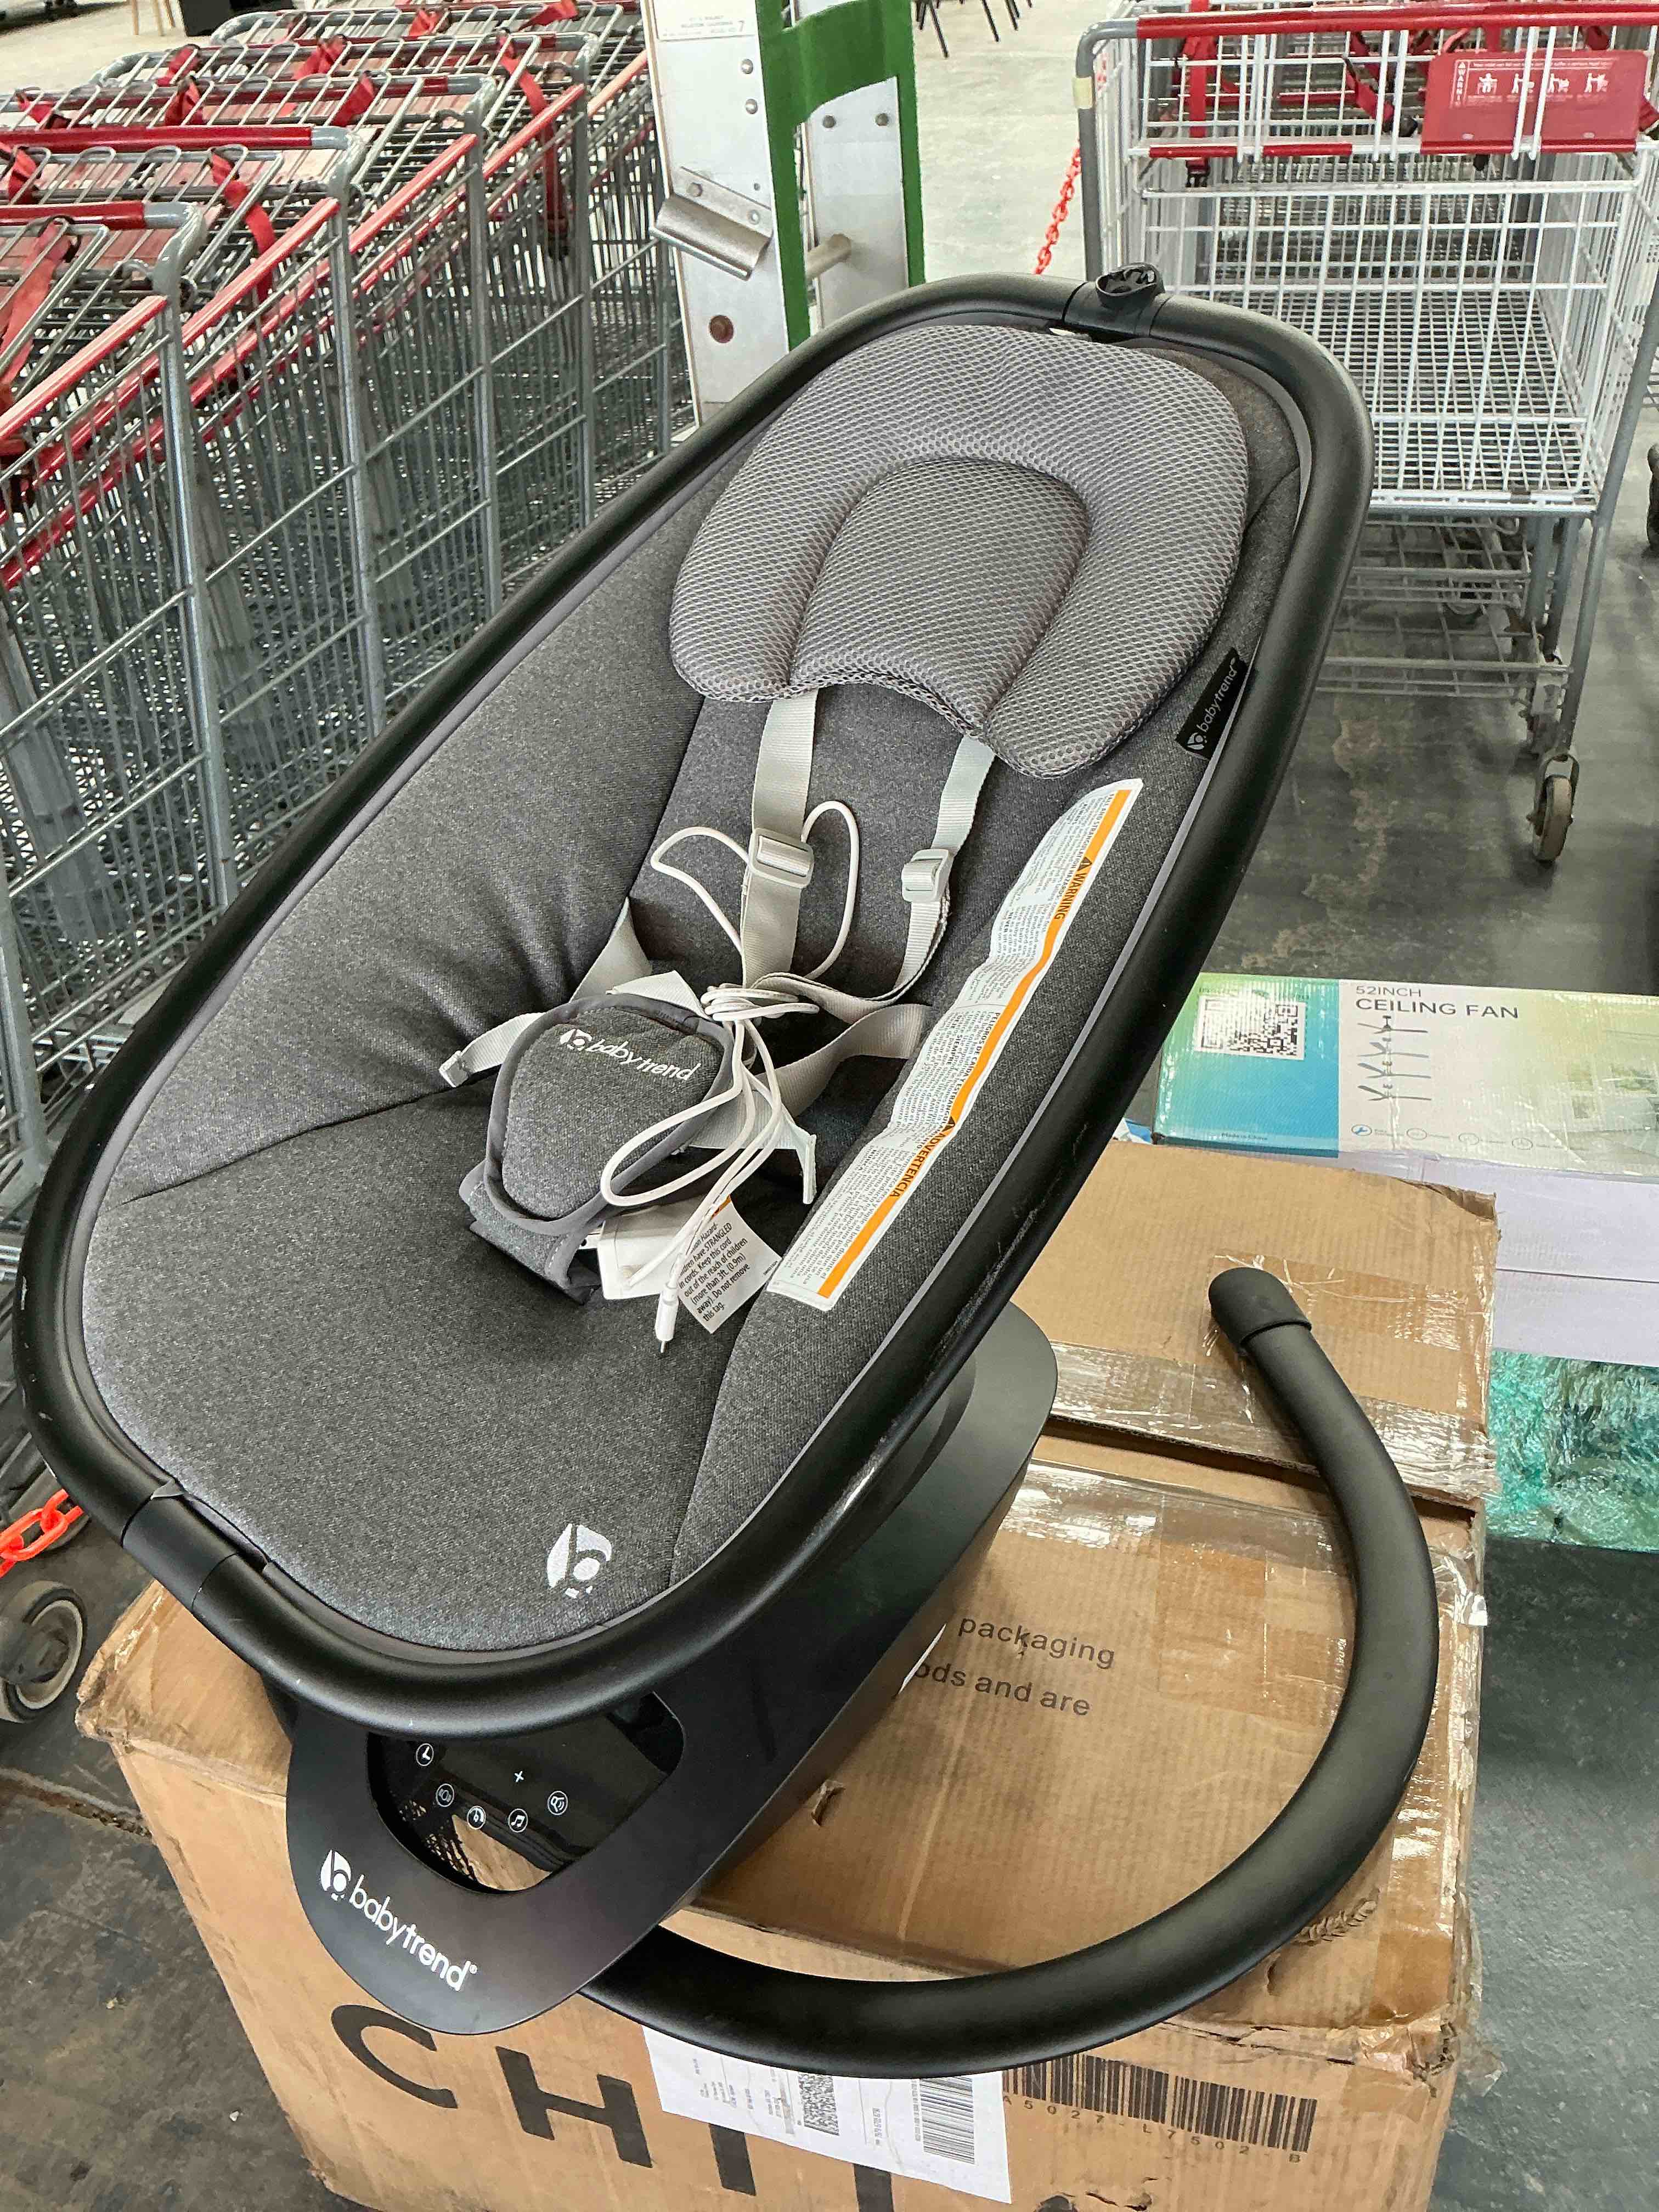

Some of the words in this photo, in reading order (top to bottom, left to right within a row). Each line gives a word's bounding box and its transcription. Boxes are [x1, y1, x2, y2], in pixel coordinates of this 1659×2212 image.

[1197, 657, 1238, 733] babytrend
[1054, 872, 1086, 920] WARNING
[1356, 985, 1421, 997] 52INCH
[1356, 998, 1457, 1015] CEILING
[1466, 1005, 1519, 1019] FAN
[978, 1012, 1000, 1044] PELIGROS
[585, 1039, 702, 1081] babytrend
[945, 1035, 963, 1065] SIEMPRE
[973, 1046, 983, 1054] DE
[889, 1132, 946, 1198] ADVERTENCIA
[691, 1247, 707, 1262] have
[702, 1221, 733, 1251] STRANGLED
[696, 1255, 713, 1271] Keep
[708, 1246, 721, 1260] this
[718, 1236, 732, 1251] cord
[682, 1285, 695, 1297] out
[690, 1278, 701, 1289] of
[697, 1272, 709, 1284] the
[706, 1260, 723, 1276] reach
[719, 1254, 729, 1263] of
[724, 1235, 748, 1259] children
[689, 1285, 709, 1306] (more
[704, 1276, 720, 1291] than
[725, 1251, 747, 1273] (0.9m)
[711, 1286, 723, 1299] Do
[720, 1279, 732, 1292] not
[730, 1262, 751, 1283] remove
[702, 1309, 715, 1322] this
[711, 1300, 726, 1315] tag.
[957, 1618, 1115, 1669] packaging
[914, 1663, 966, 1687] ods
[975, 1675, 1032, 1702] and
[1040, 1690, 1090, 1716] are
[348, 1874, 472, 1992] babytrend
